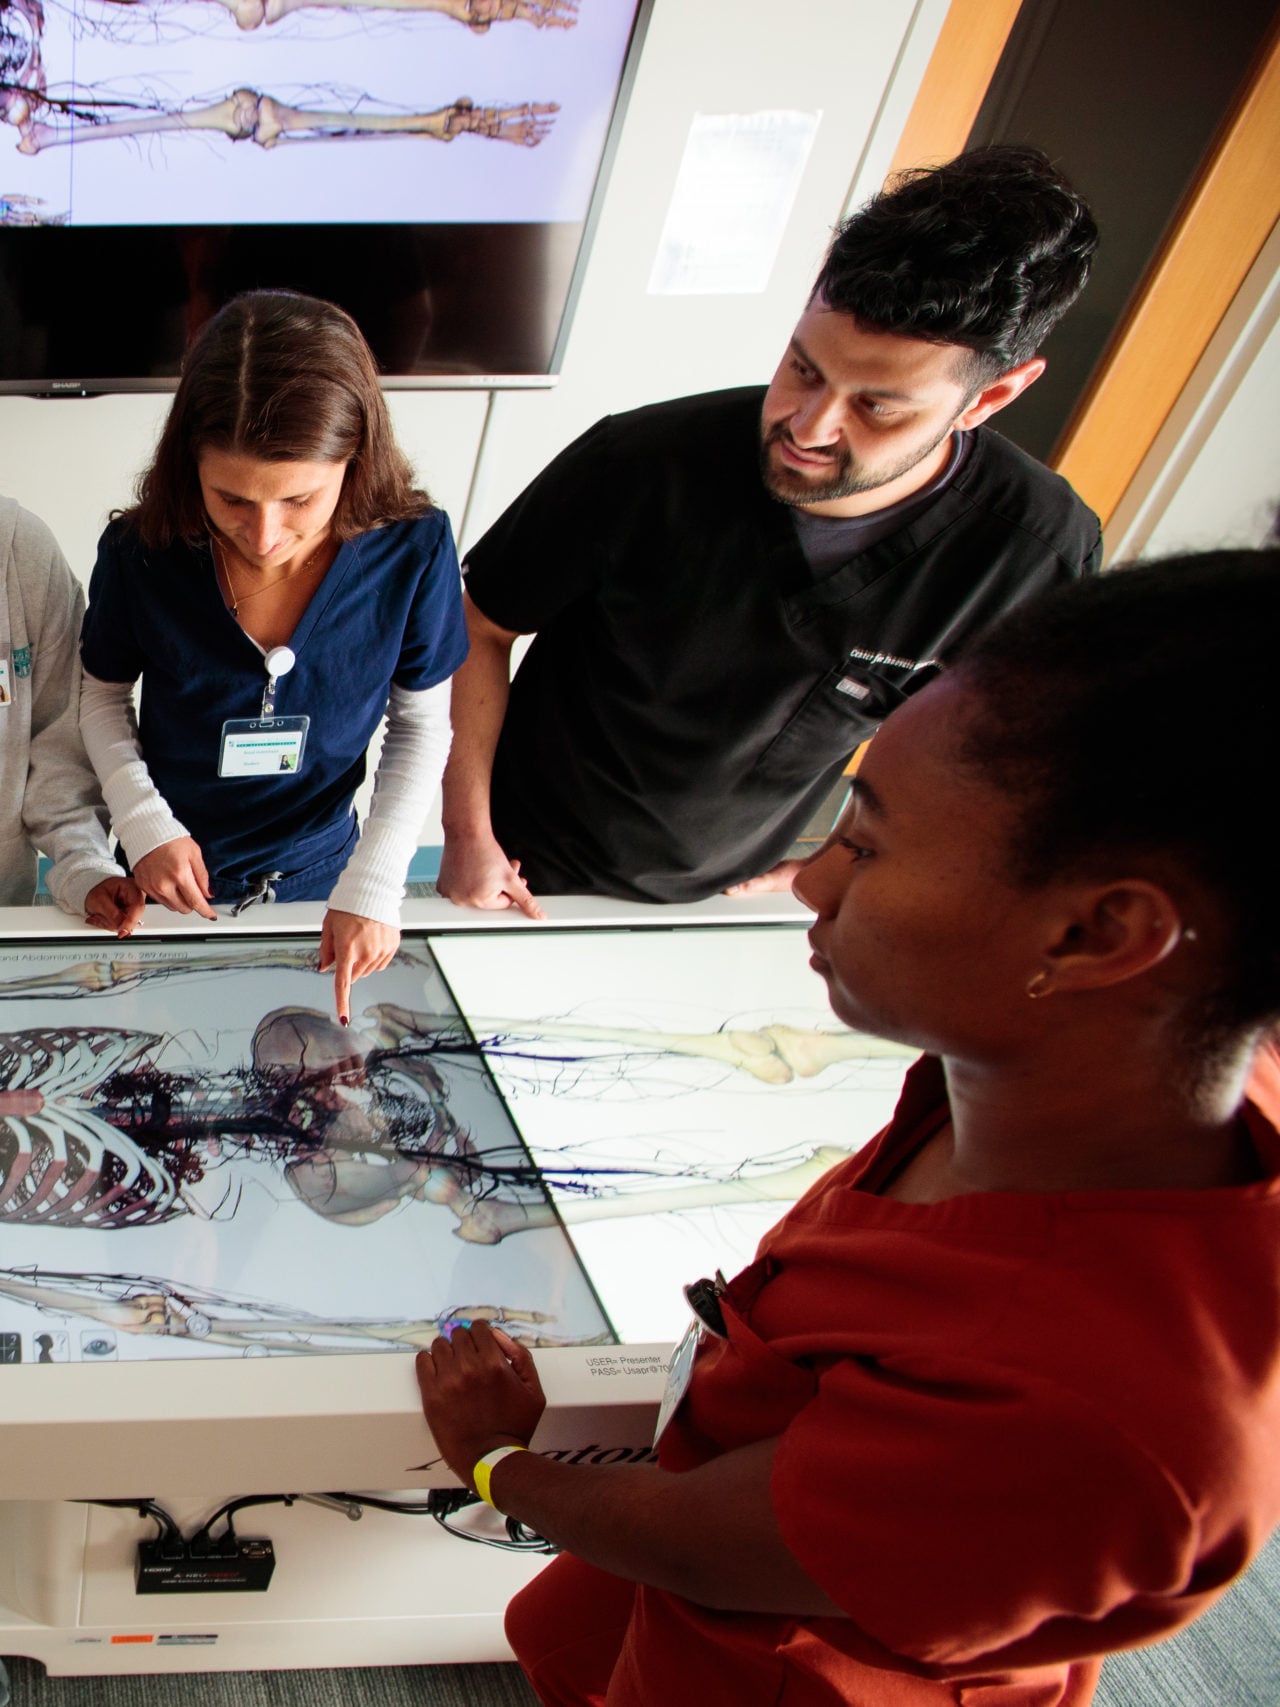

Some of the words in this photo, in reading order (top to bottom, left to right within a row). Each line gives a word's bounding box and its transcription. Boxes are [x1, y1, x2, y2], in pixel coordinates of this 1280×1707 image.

[21, 952, 81, 961] Abdominal)
[586, 1357, 618, 1367] USER=
[619, 1355, 661, 1365] Presenter
[590, 1367, 622, 1376] PASS=
